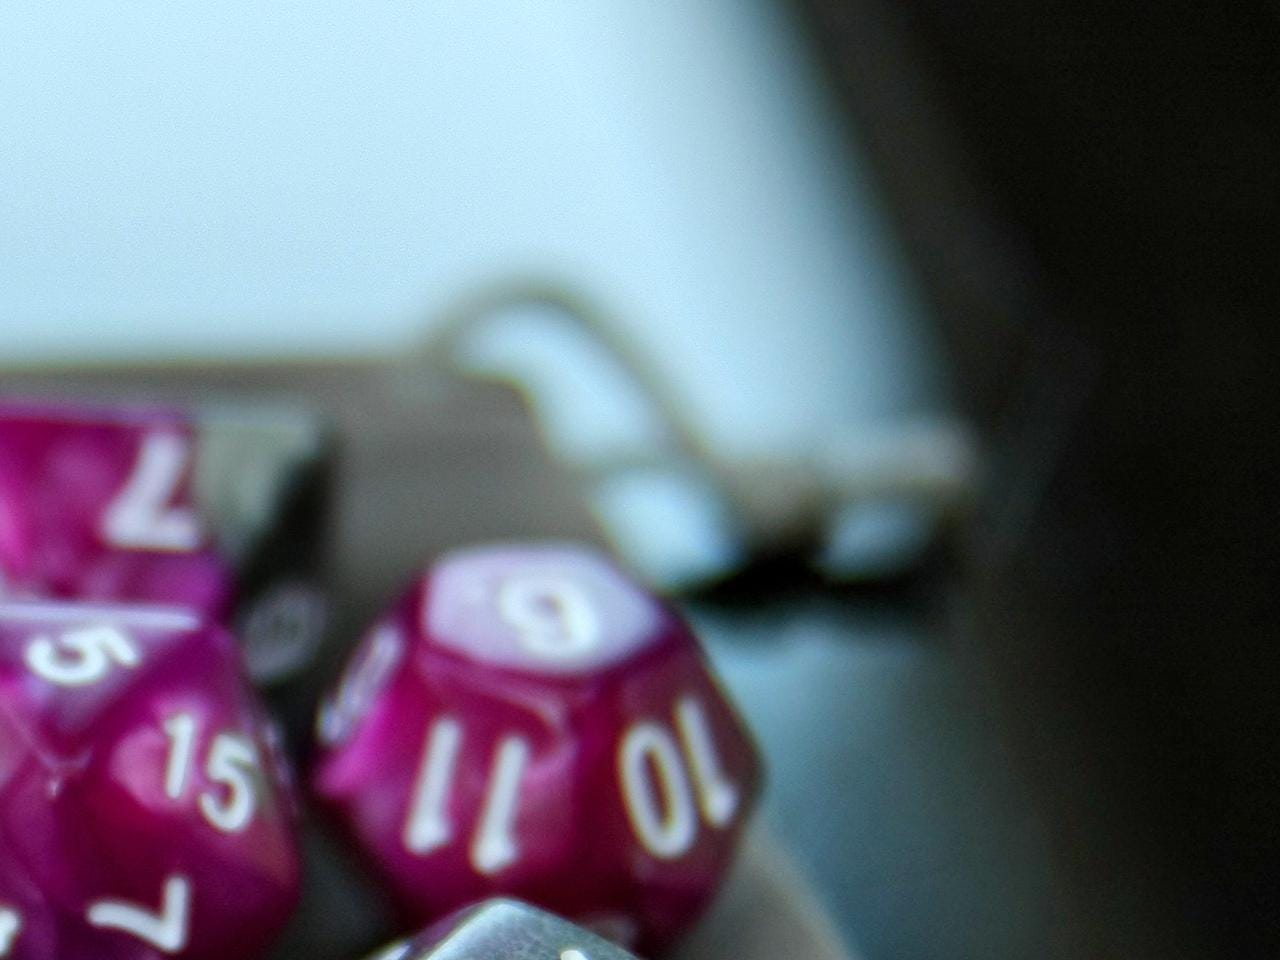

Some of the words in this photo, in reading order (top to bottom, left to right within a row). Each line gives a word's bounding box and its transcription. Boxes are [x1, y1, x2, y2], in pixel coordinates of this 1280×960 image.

[102, 428, 200, 551] 7
[27, 627, 140, 684] 5
[164, 712, 259, 833] 15
[403, 716, 528, 874] 11
[620, 697, 738, 859] 10
[87, 876, 190, 953] 7
